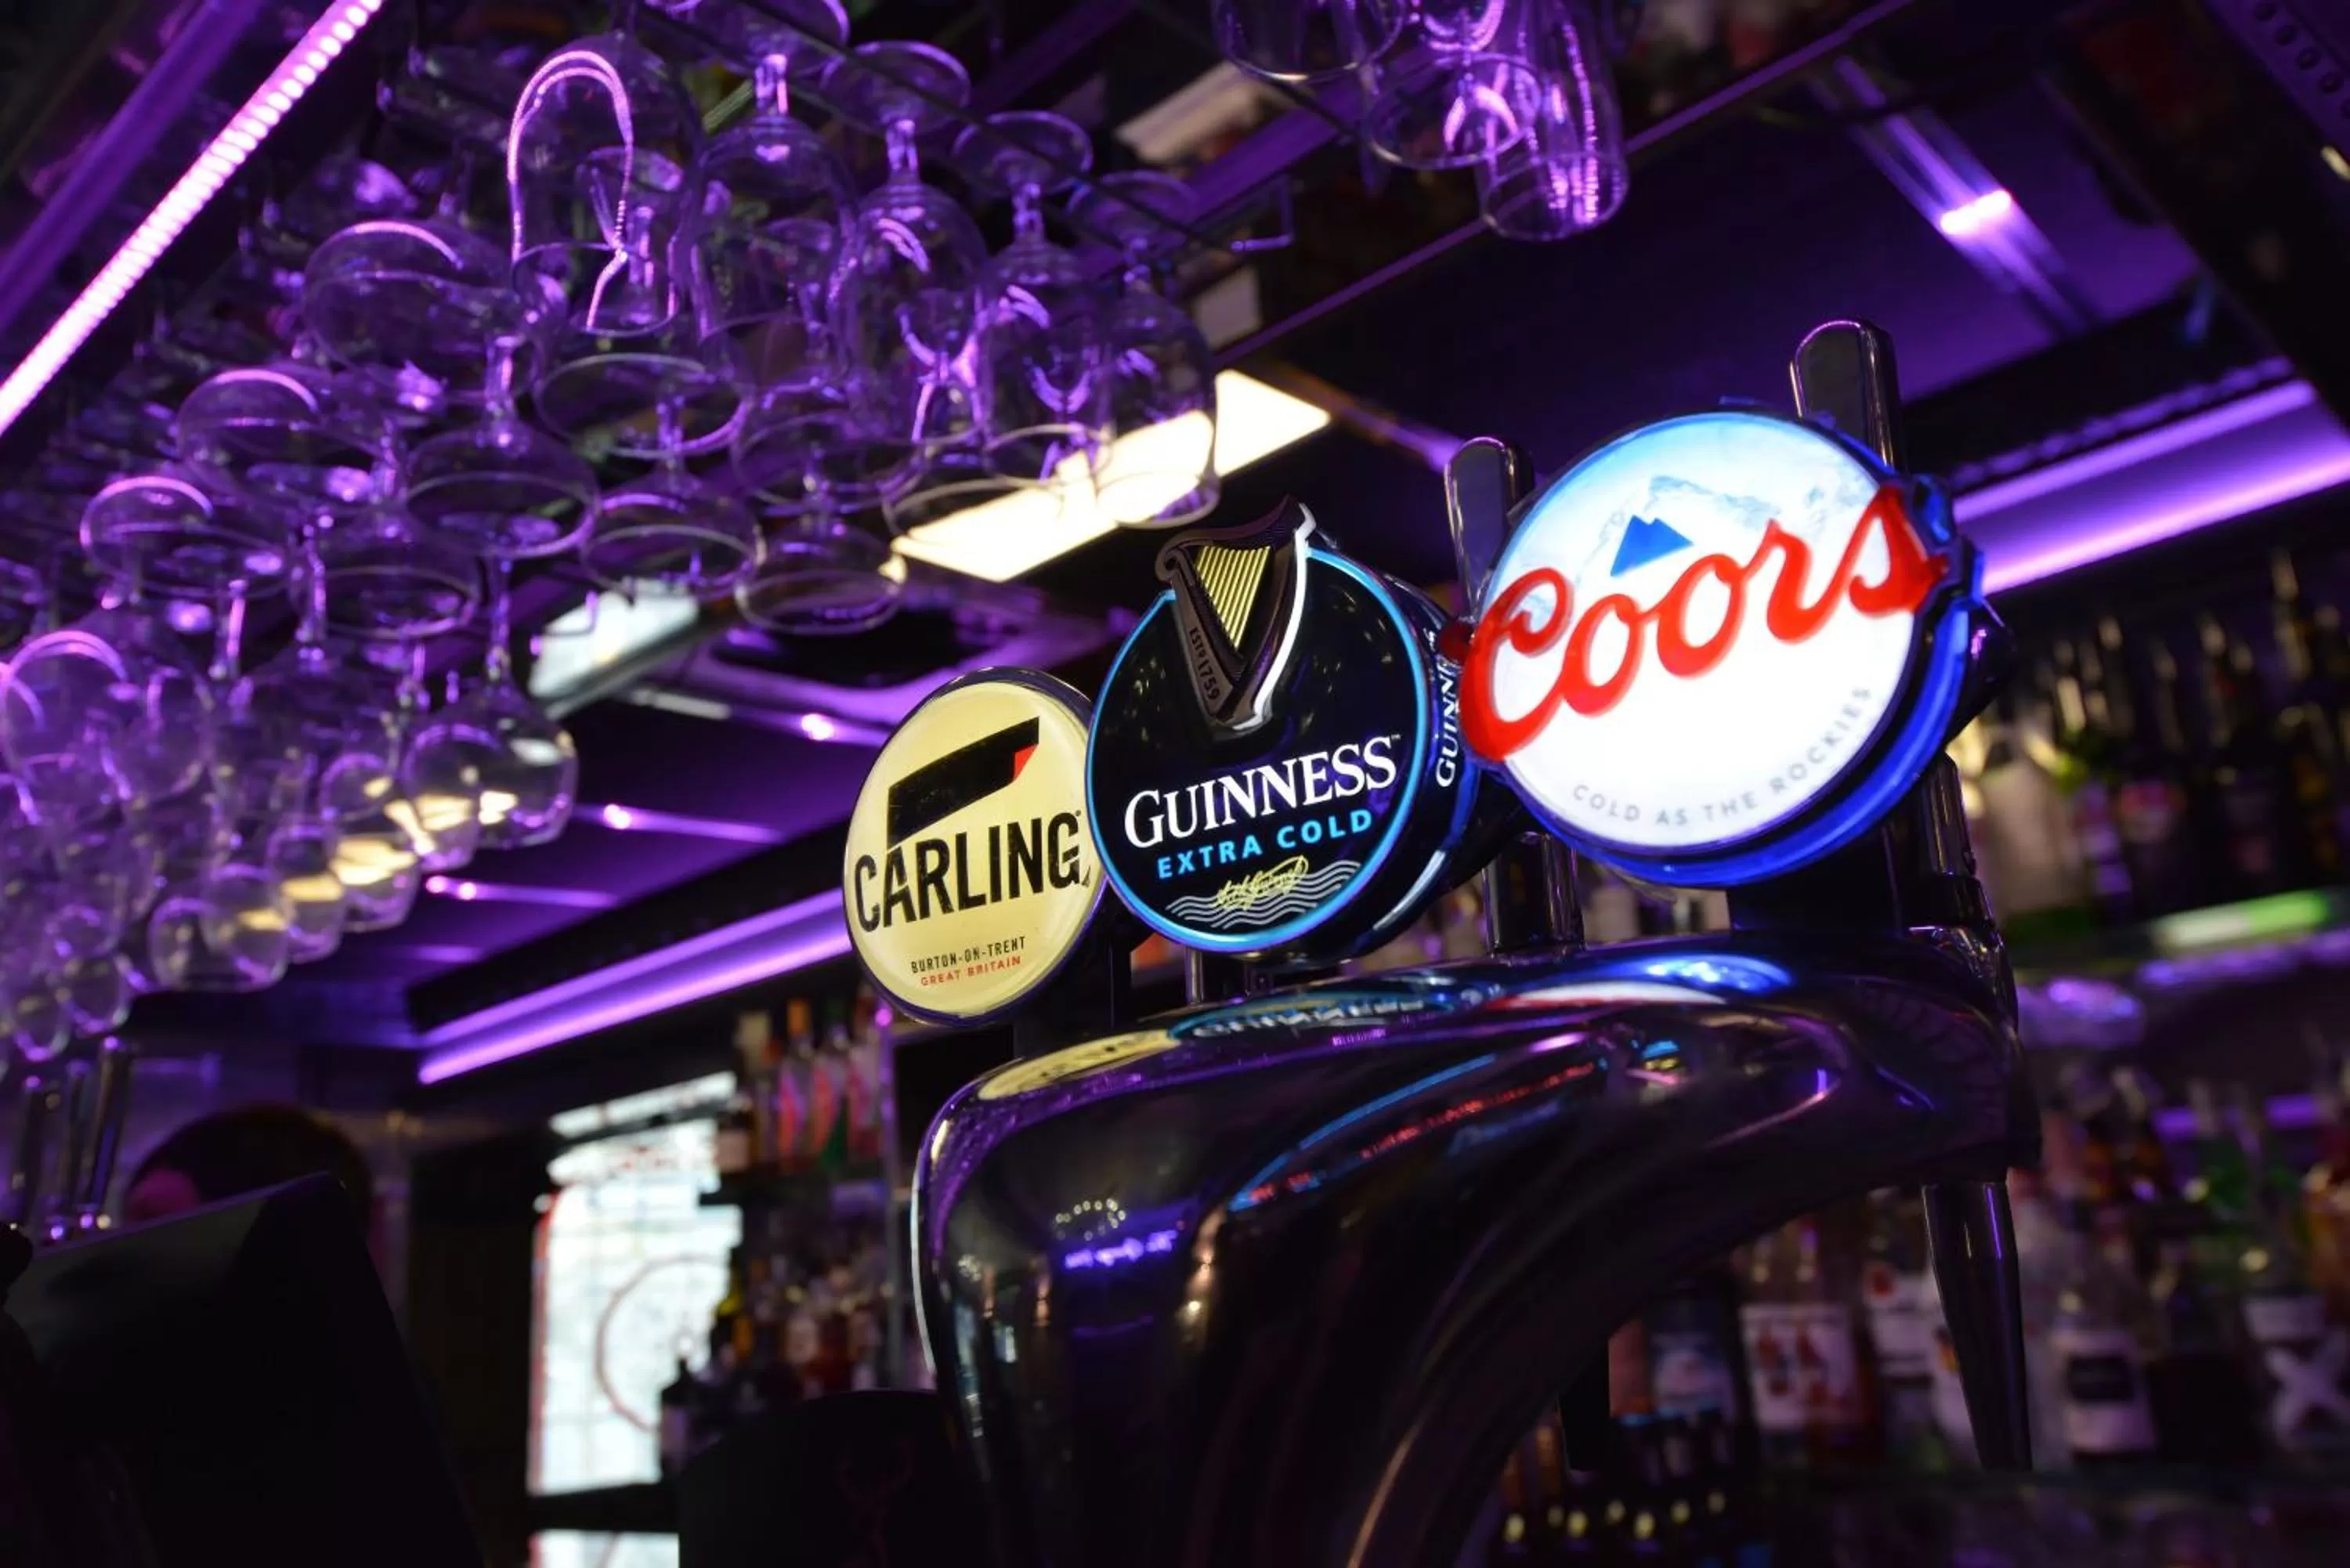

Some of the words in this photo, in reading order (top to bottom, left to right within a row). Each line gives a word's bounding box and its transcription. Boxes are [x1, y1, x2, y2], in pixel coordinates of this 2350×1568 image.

[1459, 483, 1949, 761] Coors
[1198, 659, 1220, 700] 1759
[1123, 735, 1397, 849] GUINNESS
[1572, 783, 1641, 822] COLD
[1655, 807, 1688, 826] AS
[1702, 790, 1758, 823] THE
[1768, 688, 1871, 794] ROCKIES
[854, 811, 1080, 932] CARLING
[1157, 834, 1263, 880] EXTRA
[1277, 808, 1372, 849] COLD
[910, 935, 1026, 974] BURTON-ON-TRENT
[920, 970, 961, 987] GREAT
[967, 955, 1021, 977] BRITAIN
